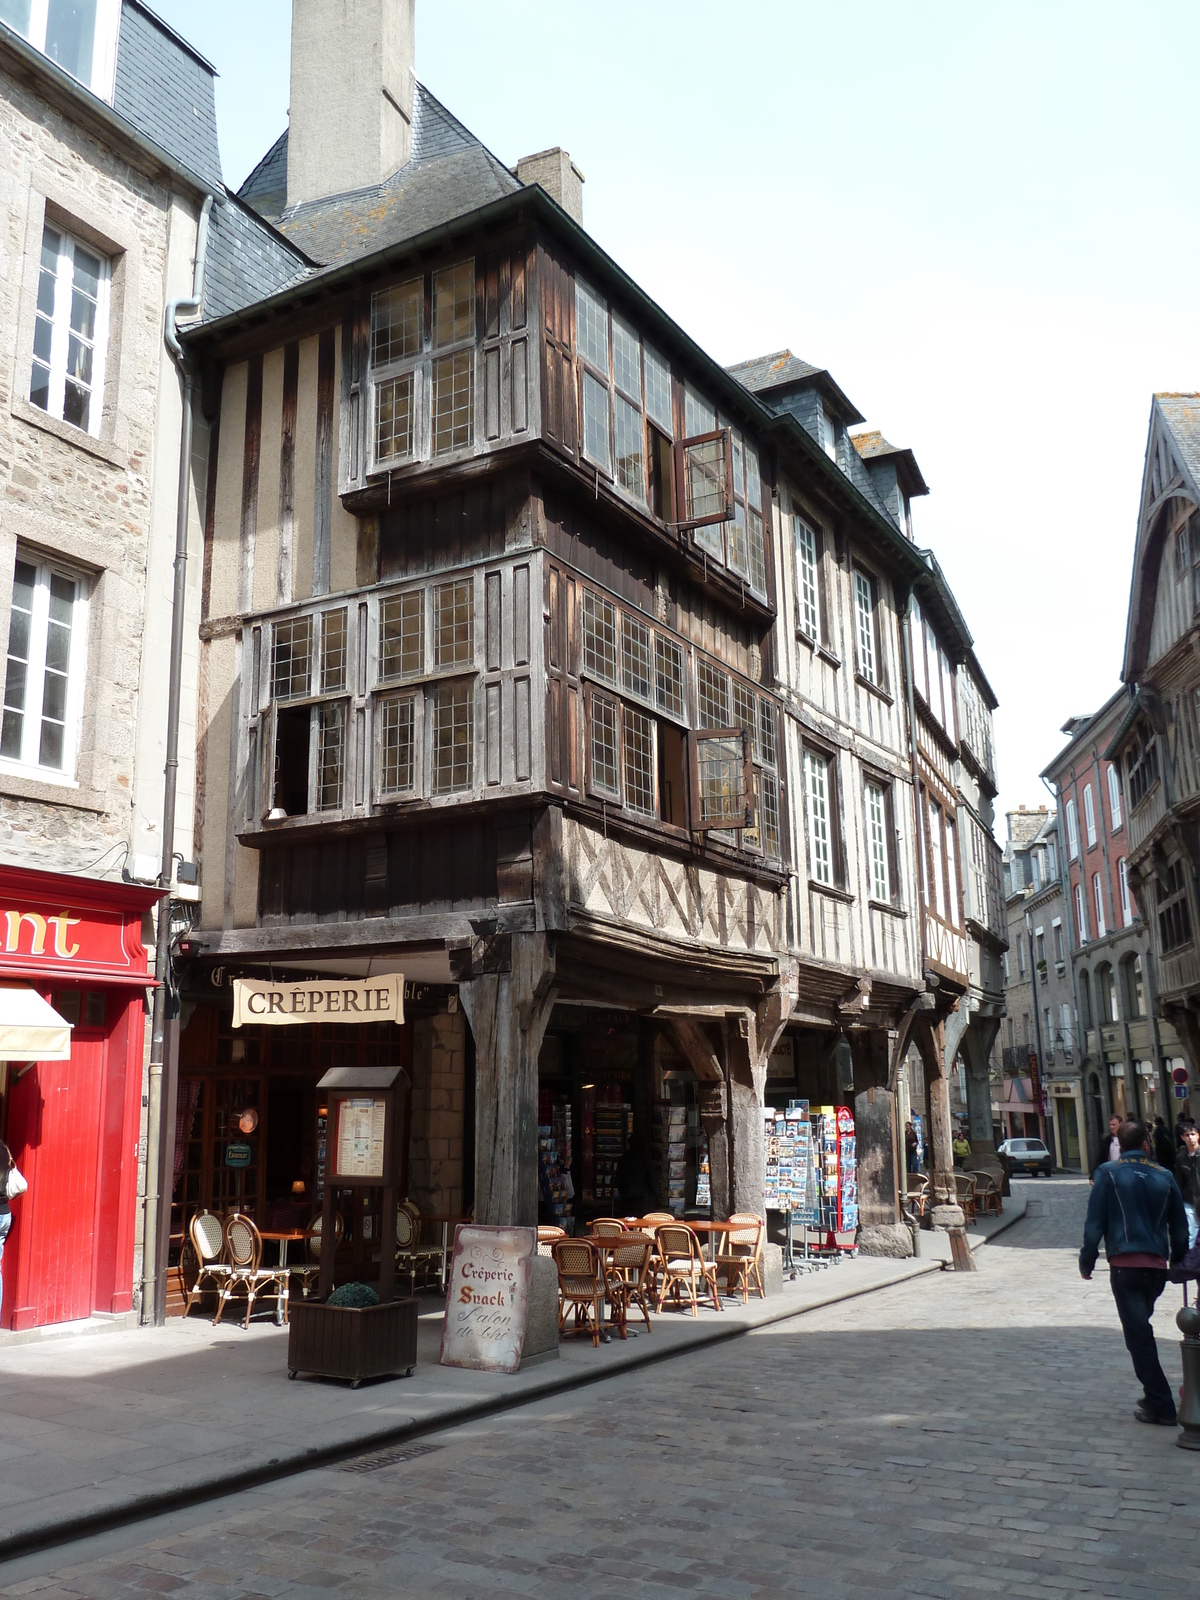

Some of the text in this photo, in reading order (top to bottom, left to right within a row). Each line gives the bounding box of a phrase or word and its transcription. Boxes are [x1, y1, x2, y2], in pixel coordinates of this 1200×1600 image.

[0, 909, 82, 958] nt
[247, 986, 391, 1014] CRÊPERIE
[404, 981, 429, 1001] ble"
[461, 1261, 514, 1282] Crêperie
[457, 1285, 505, 1306] Snack
[457, 1306, 511, 1325] Salon
